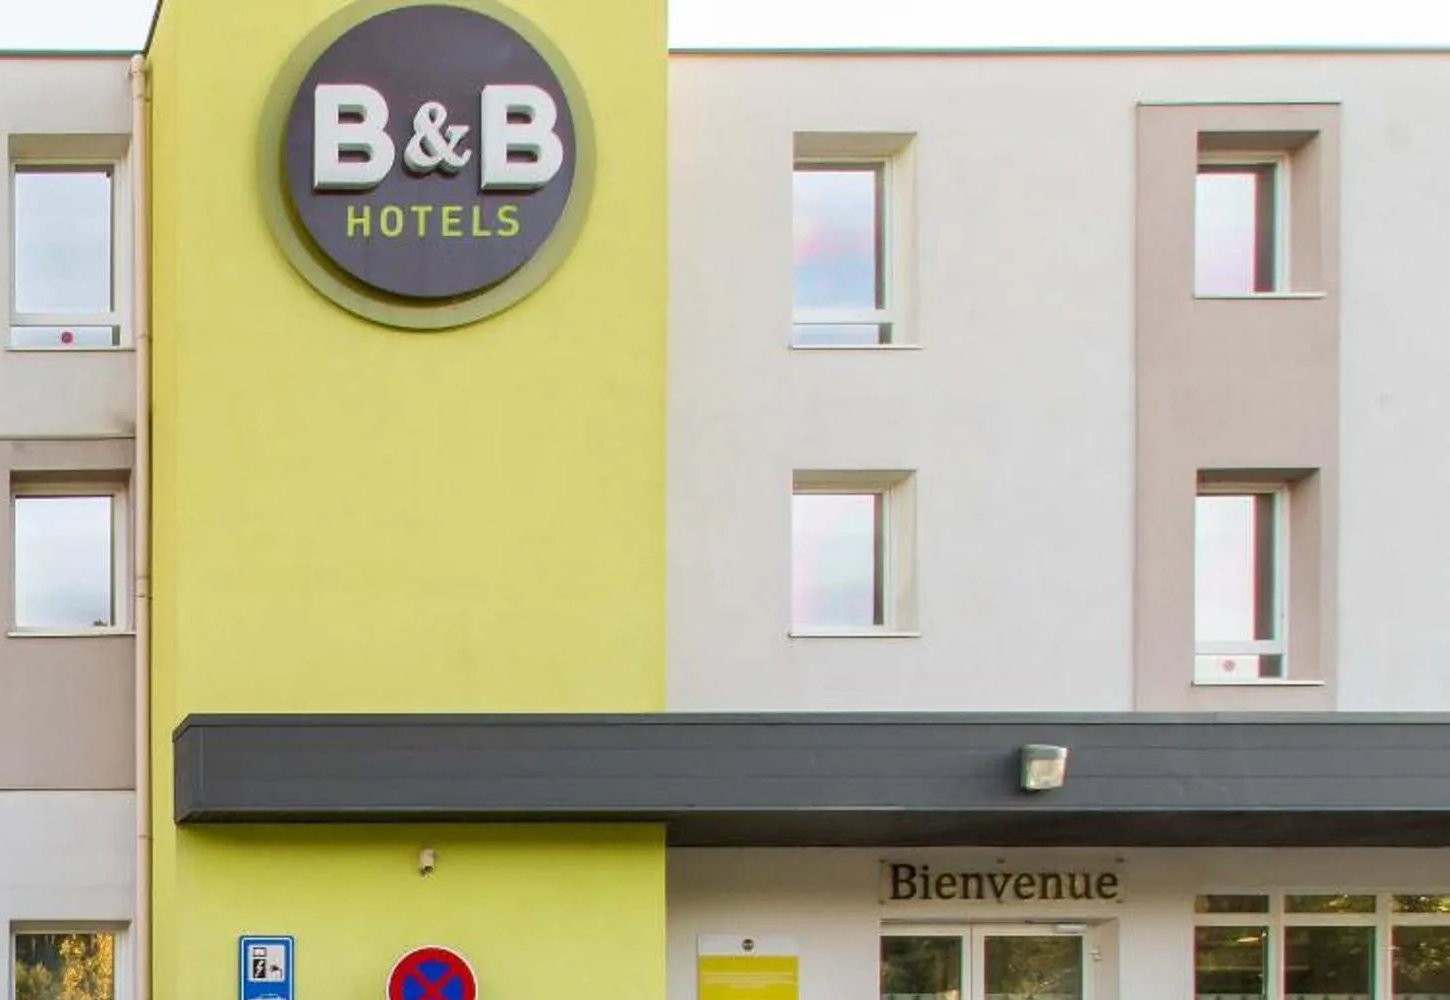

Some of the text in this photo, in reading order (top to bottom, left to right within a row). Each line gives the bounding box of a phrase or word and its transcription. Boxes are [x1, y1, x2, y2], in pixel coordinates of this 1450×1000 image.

[313, 83, 564, 190] B&B
[346, 204, 521, 238] HOTELS
[889, 863, 1119, 901] Bienvenue
